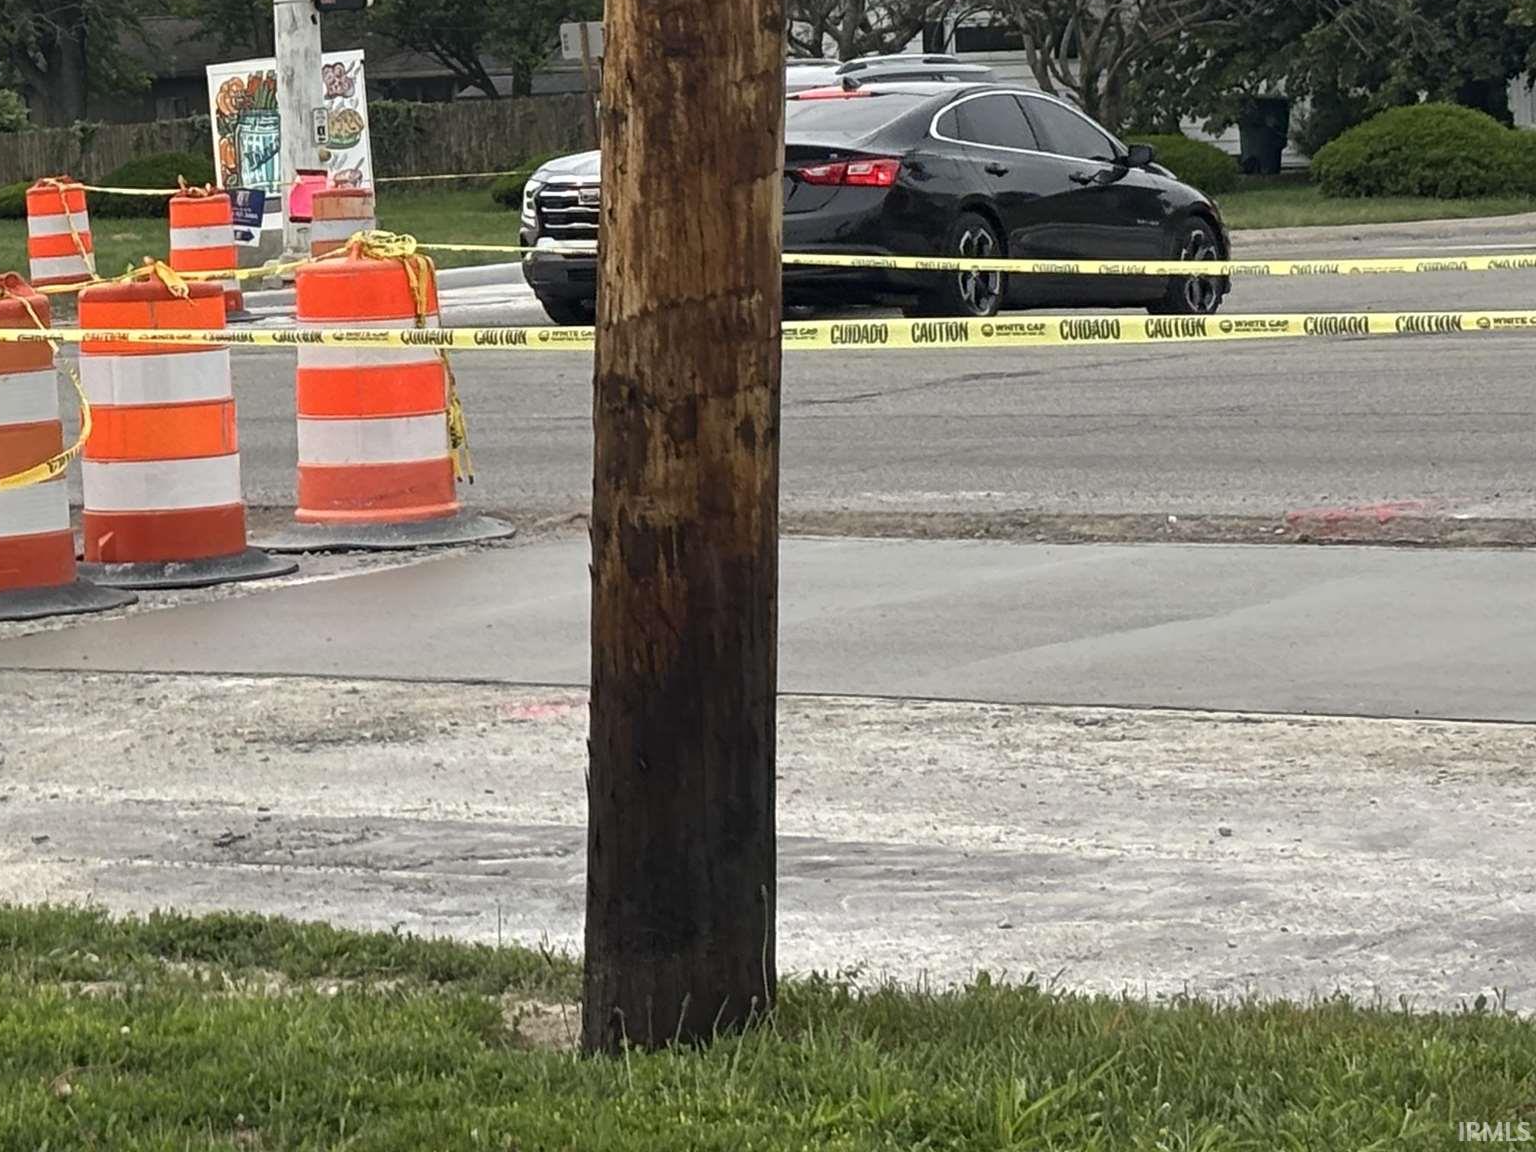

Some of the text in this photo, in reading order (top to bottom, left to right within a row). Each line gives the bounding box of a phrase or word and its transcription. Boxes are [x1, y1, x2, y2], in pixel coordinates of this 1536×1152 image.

[830, 323, 888, 344] CUIDADO
[911, 321, 968, 343] CAUTION
[995, 323, 1024, 331] WHITE
[1027, 323, 1046, 331] CAP
[1059, 319, 1121, 340] CUIDADO
[1145, 317, 1207, 338] CAUTION
[1303, 316, 1370, 336] CUIDADO
[1395, 314, 1463, 334] CAUTION
